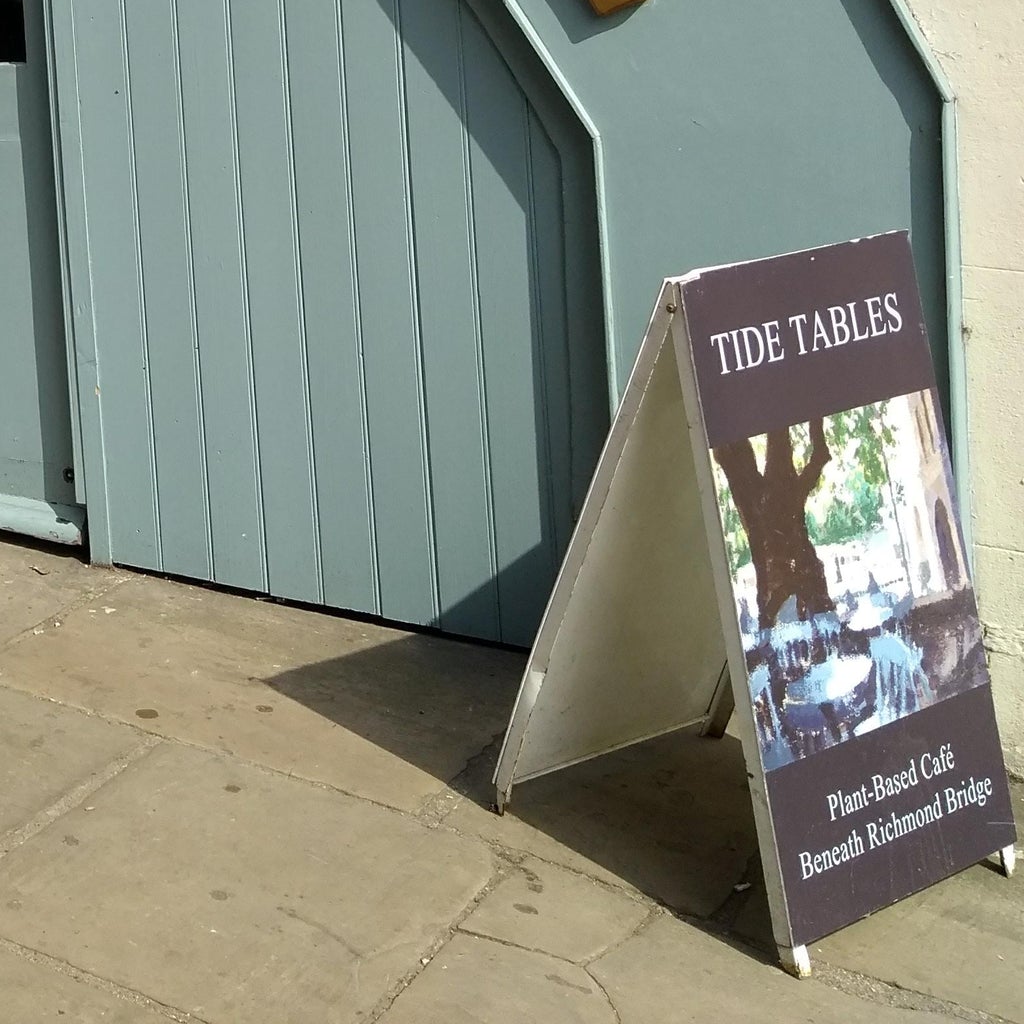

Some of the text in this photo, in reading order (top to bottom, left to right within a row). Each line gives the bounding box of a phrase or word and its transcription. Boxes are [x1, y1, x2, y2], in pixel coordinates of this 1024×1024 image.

[710, 292, 903, 375] TIDE TABLES
[826, 743, 955, 822] Plant-Based Café
[798, 776, 993, 880] Beneath Richmond Bridge
